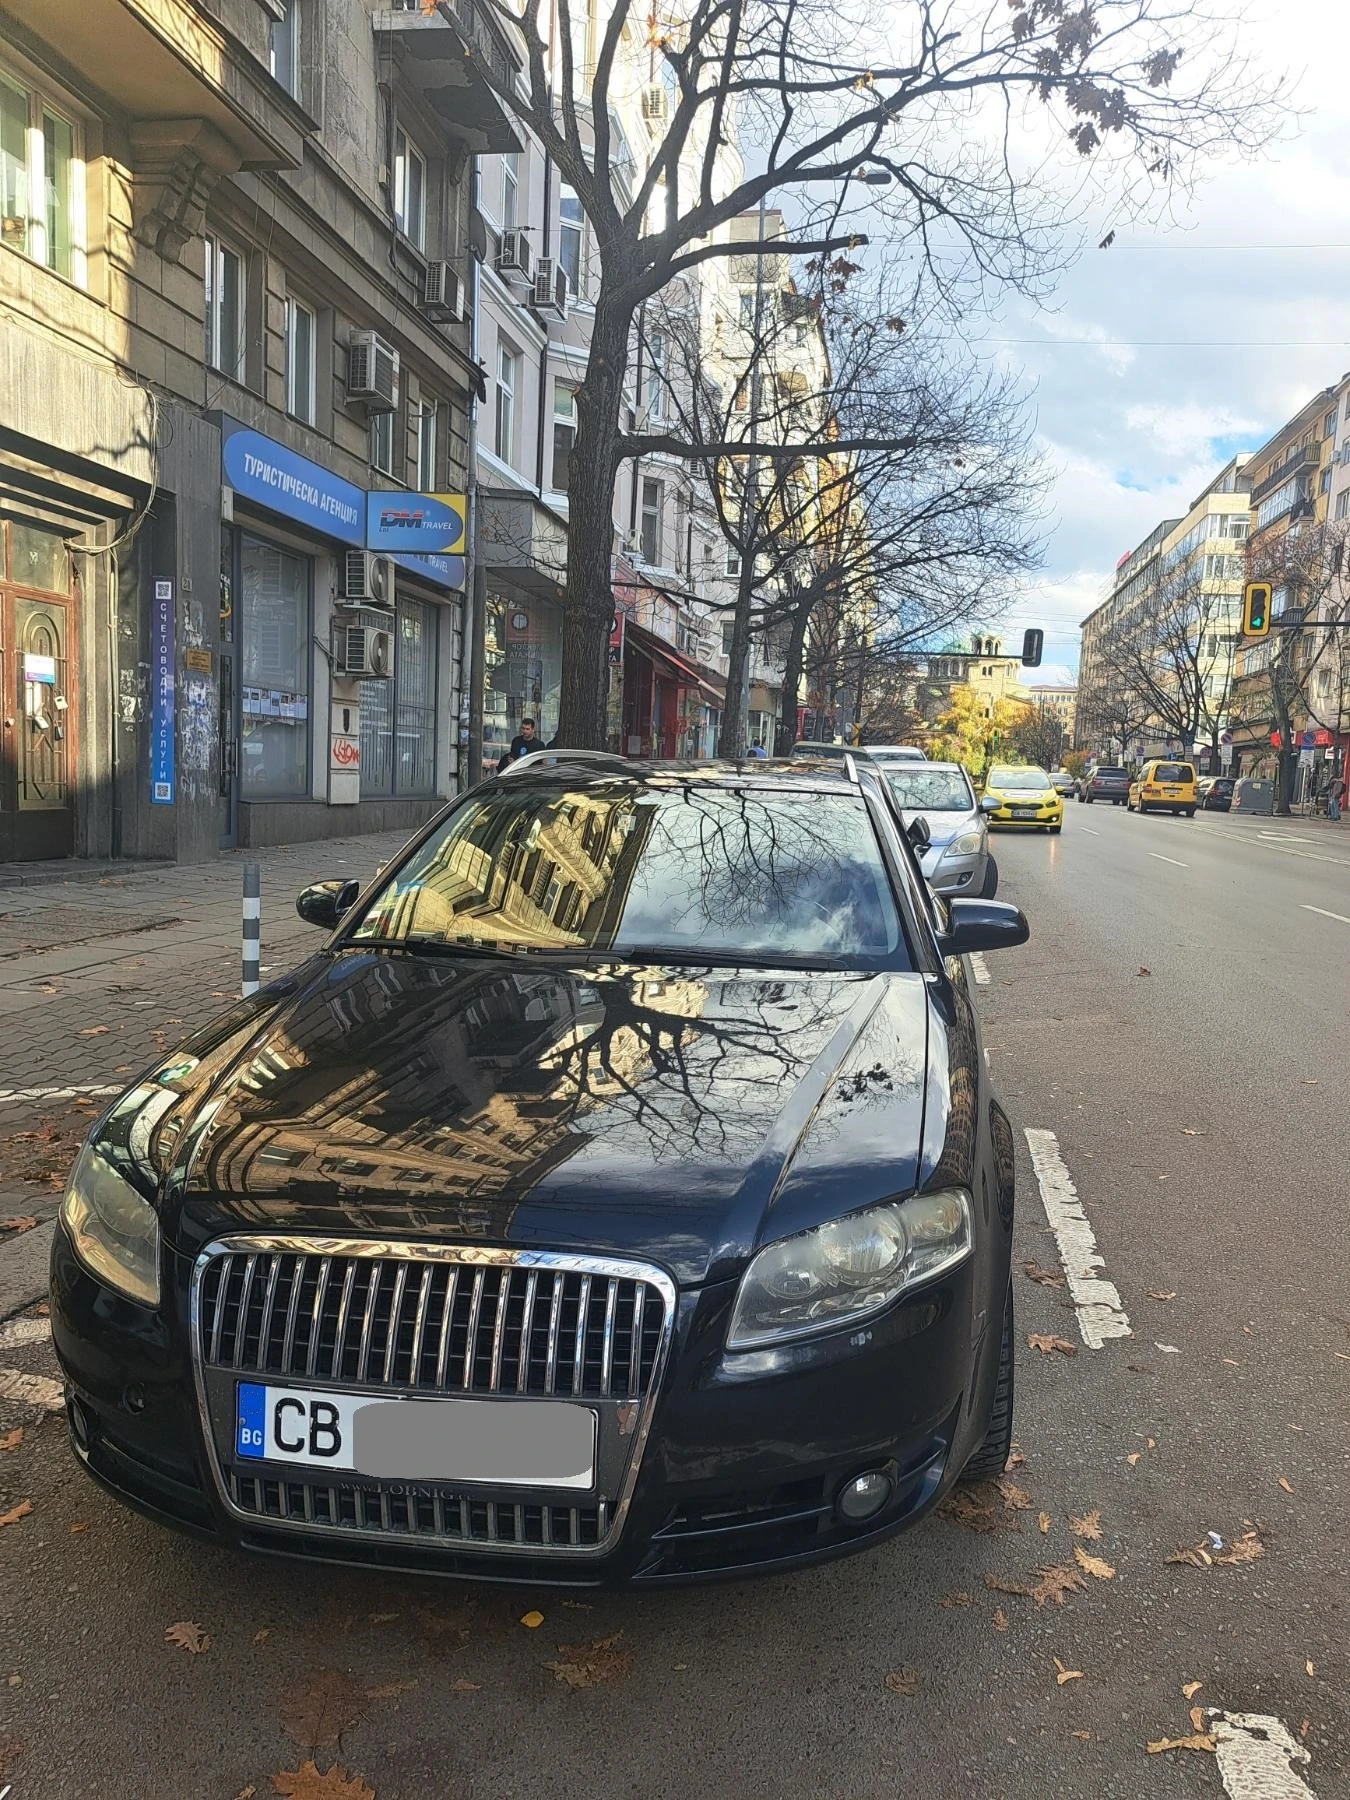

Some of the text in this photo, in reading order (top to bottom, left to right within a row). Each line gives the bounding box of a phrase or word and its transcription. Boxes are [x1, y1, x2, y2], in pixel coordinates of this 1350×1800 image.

[244, 453, 358, 526] ТУРИСТИЧЕСКА АГЕНЦИЯ
[380, 509, 453, 530] DM TRAVEL
[429, 554, 449, 573] TRAVEL
[160, 603, 168, 706] СЧЕТОВОДНИ
[241, 1428, 262, 1446] BG
[274, 1397, 342, 1457] CB
